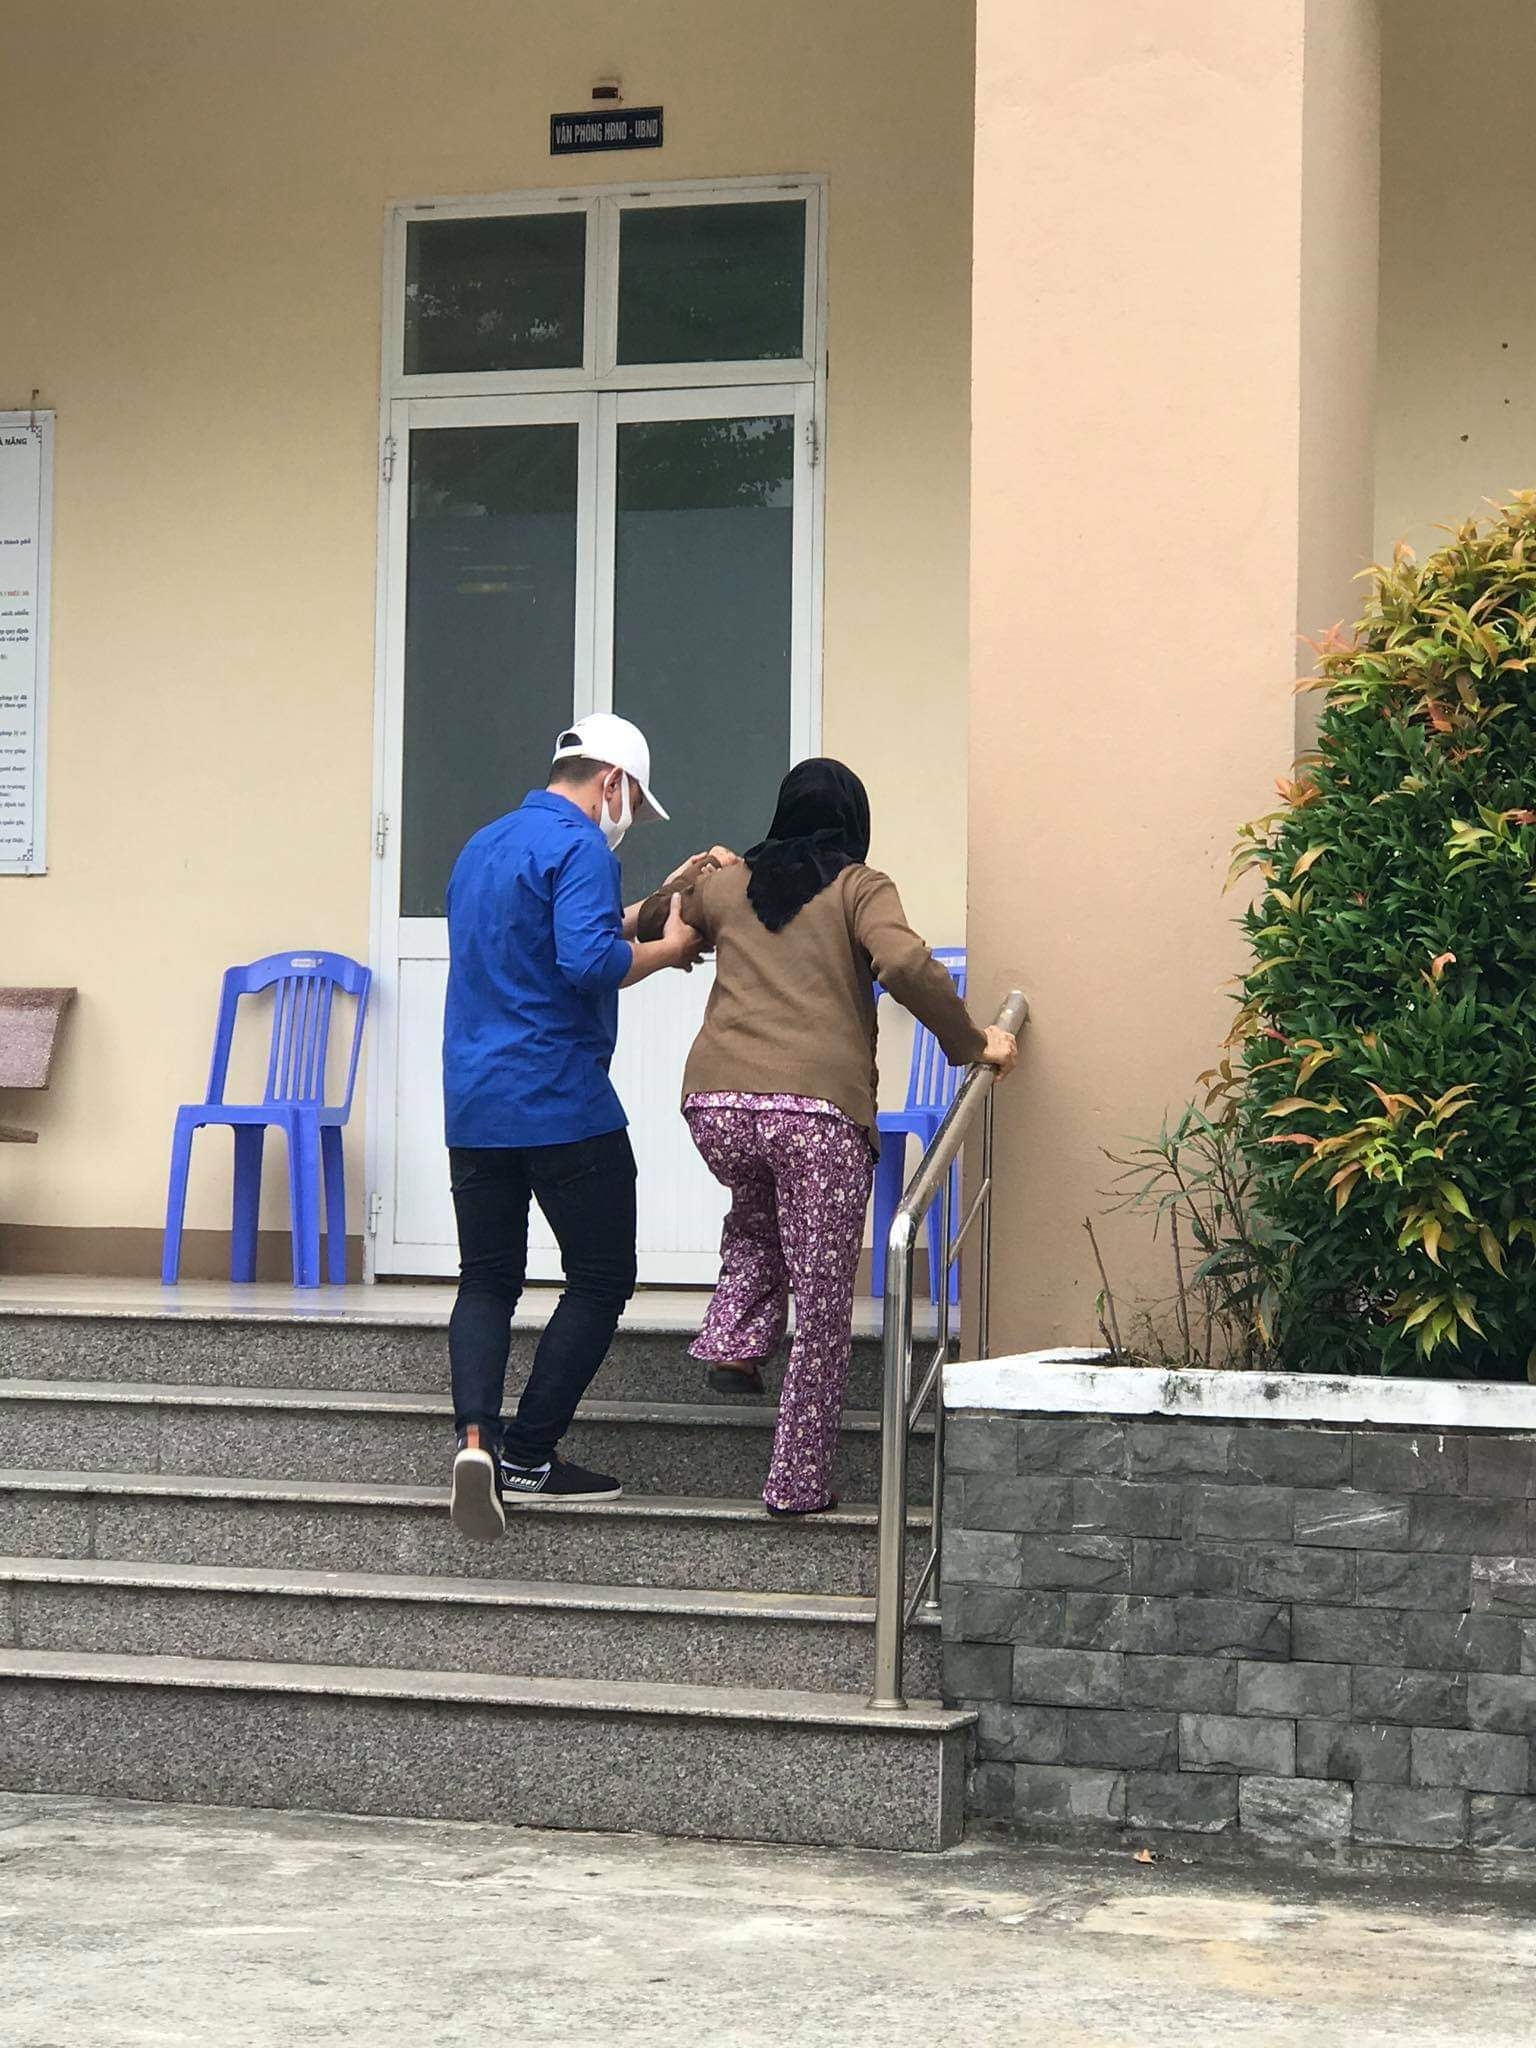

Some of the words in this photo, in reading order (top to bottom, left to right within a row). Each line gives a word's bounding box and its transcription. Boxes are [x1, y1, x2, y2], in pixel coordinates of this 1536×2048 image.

[555, 122, 573, 144] VĂN
[574, 120, 603, 143] PHÒNG
[635, 119, 658, 138] UBND
